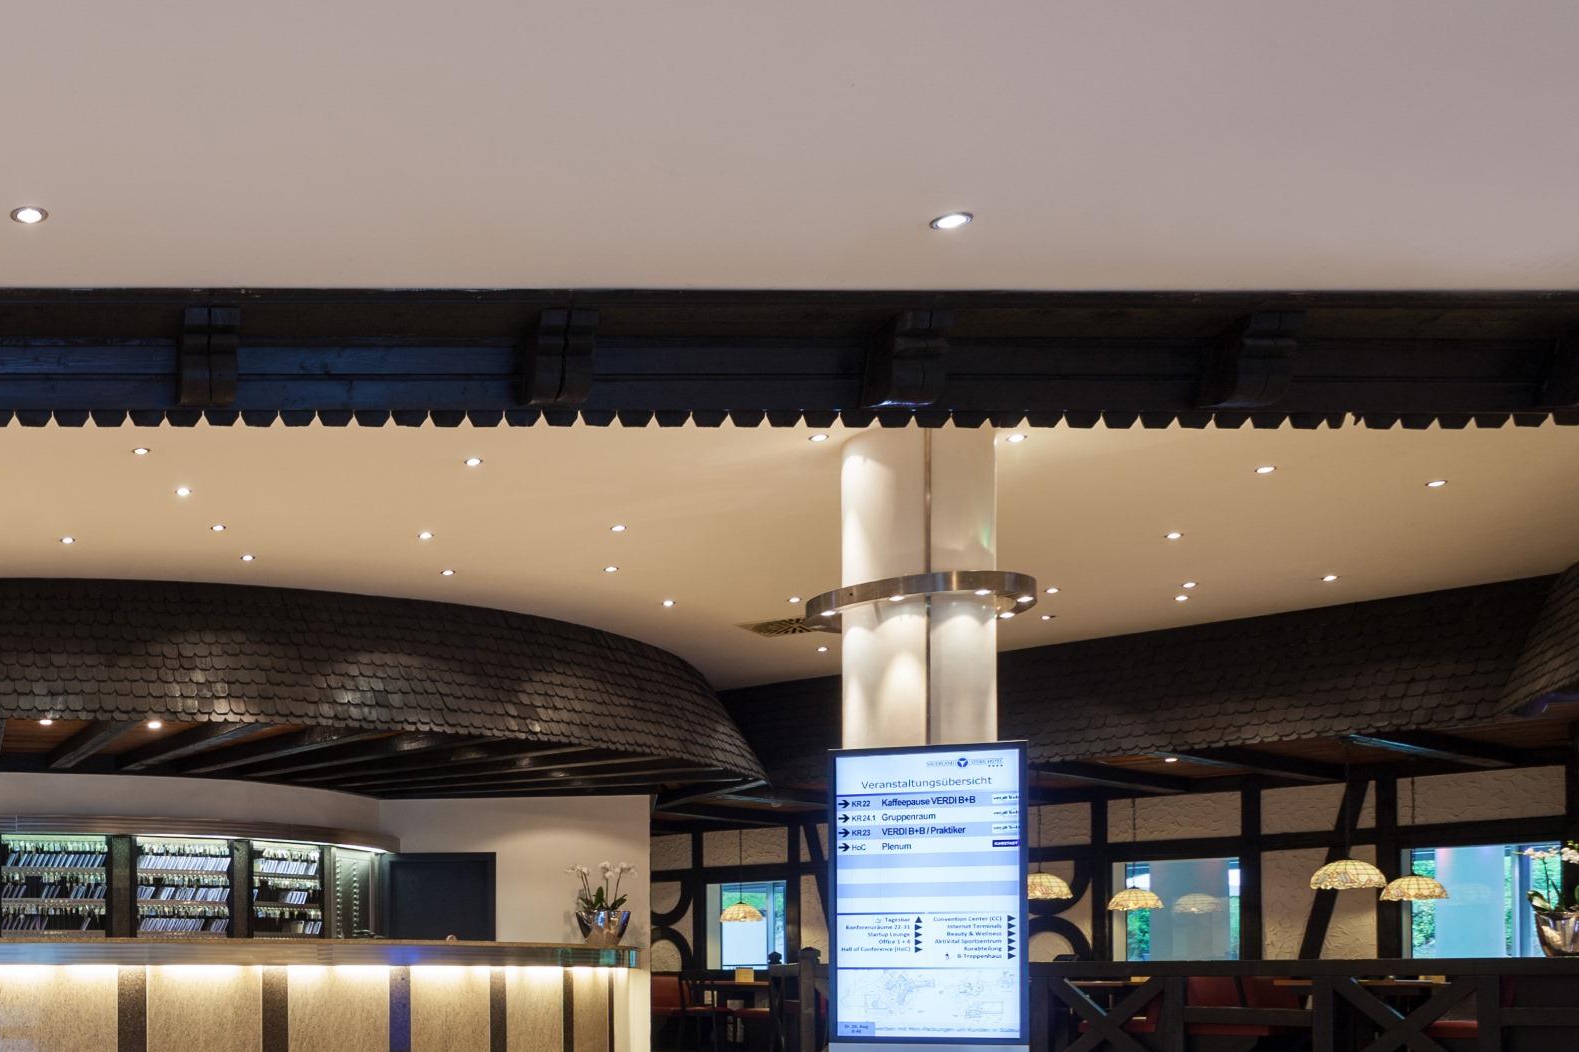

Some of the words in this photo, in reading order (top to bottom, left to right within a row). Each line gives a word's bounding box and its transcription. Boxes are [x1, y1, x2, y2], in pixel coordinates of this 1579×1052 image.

[861, 776, 993, 790] Veranstaltungsübersicht
[882, 798, 931, 808] Kaffeepause
[930, 796, 957, 805] VERDI
[958, 795, 976, 804] B+B
[881, 813, 937, 823] Gruppenraum
[882, 827, 908, 836] VERDI
[908, 826, 926, 835] B+B
[931, 826, 967, 835] Praktiker
[851, 843, 867, 851] HoC
[881, 842, 912, 851] Plenum
